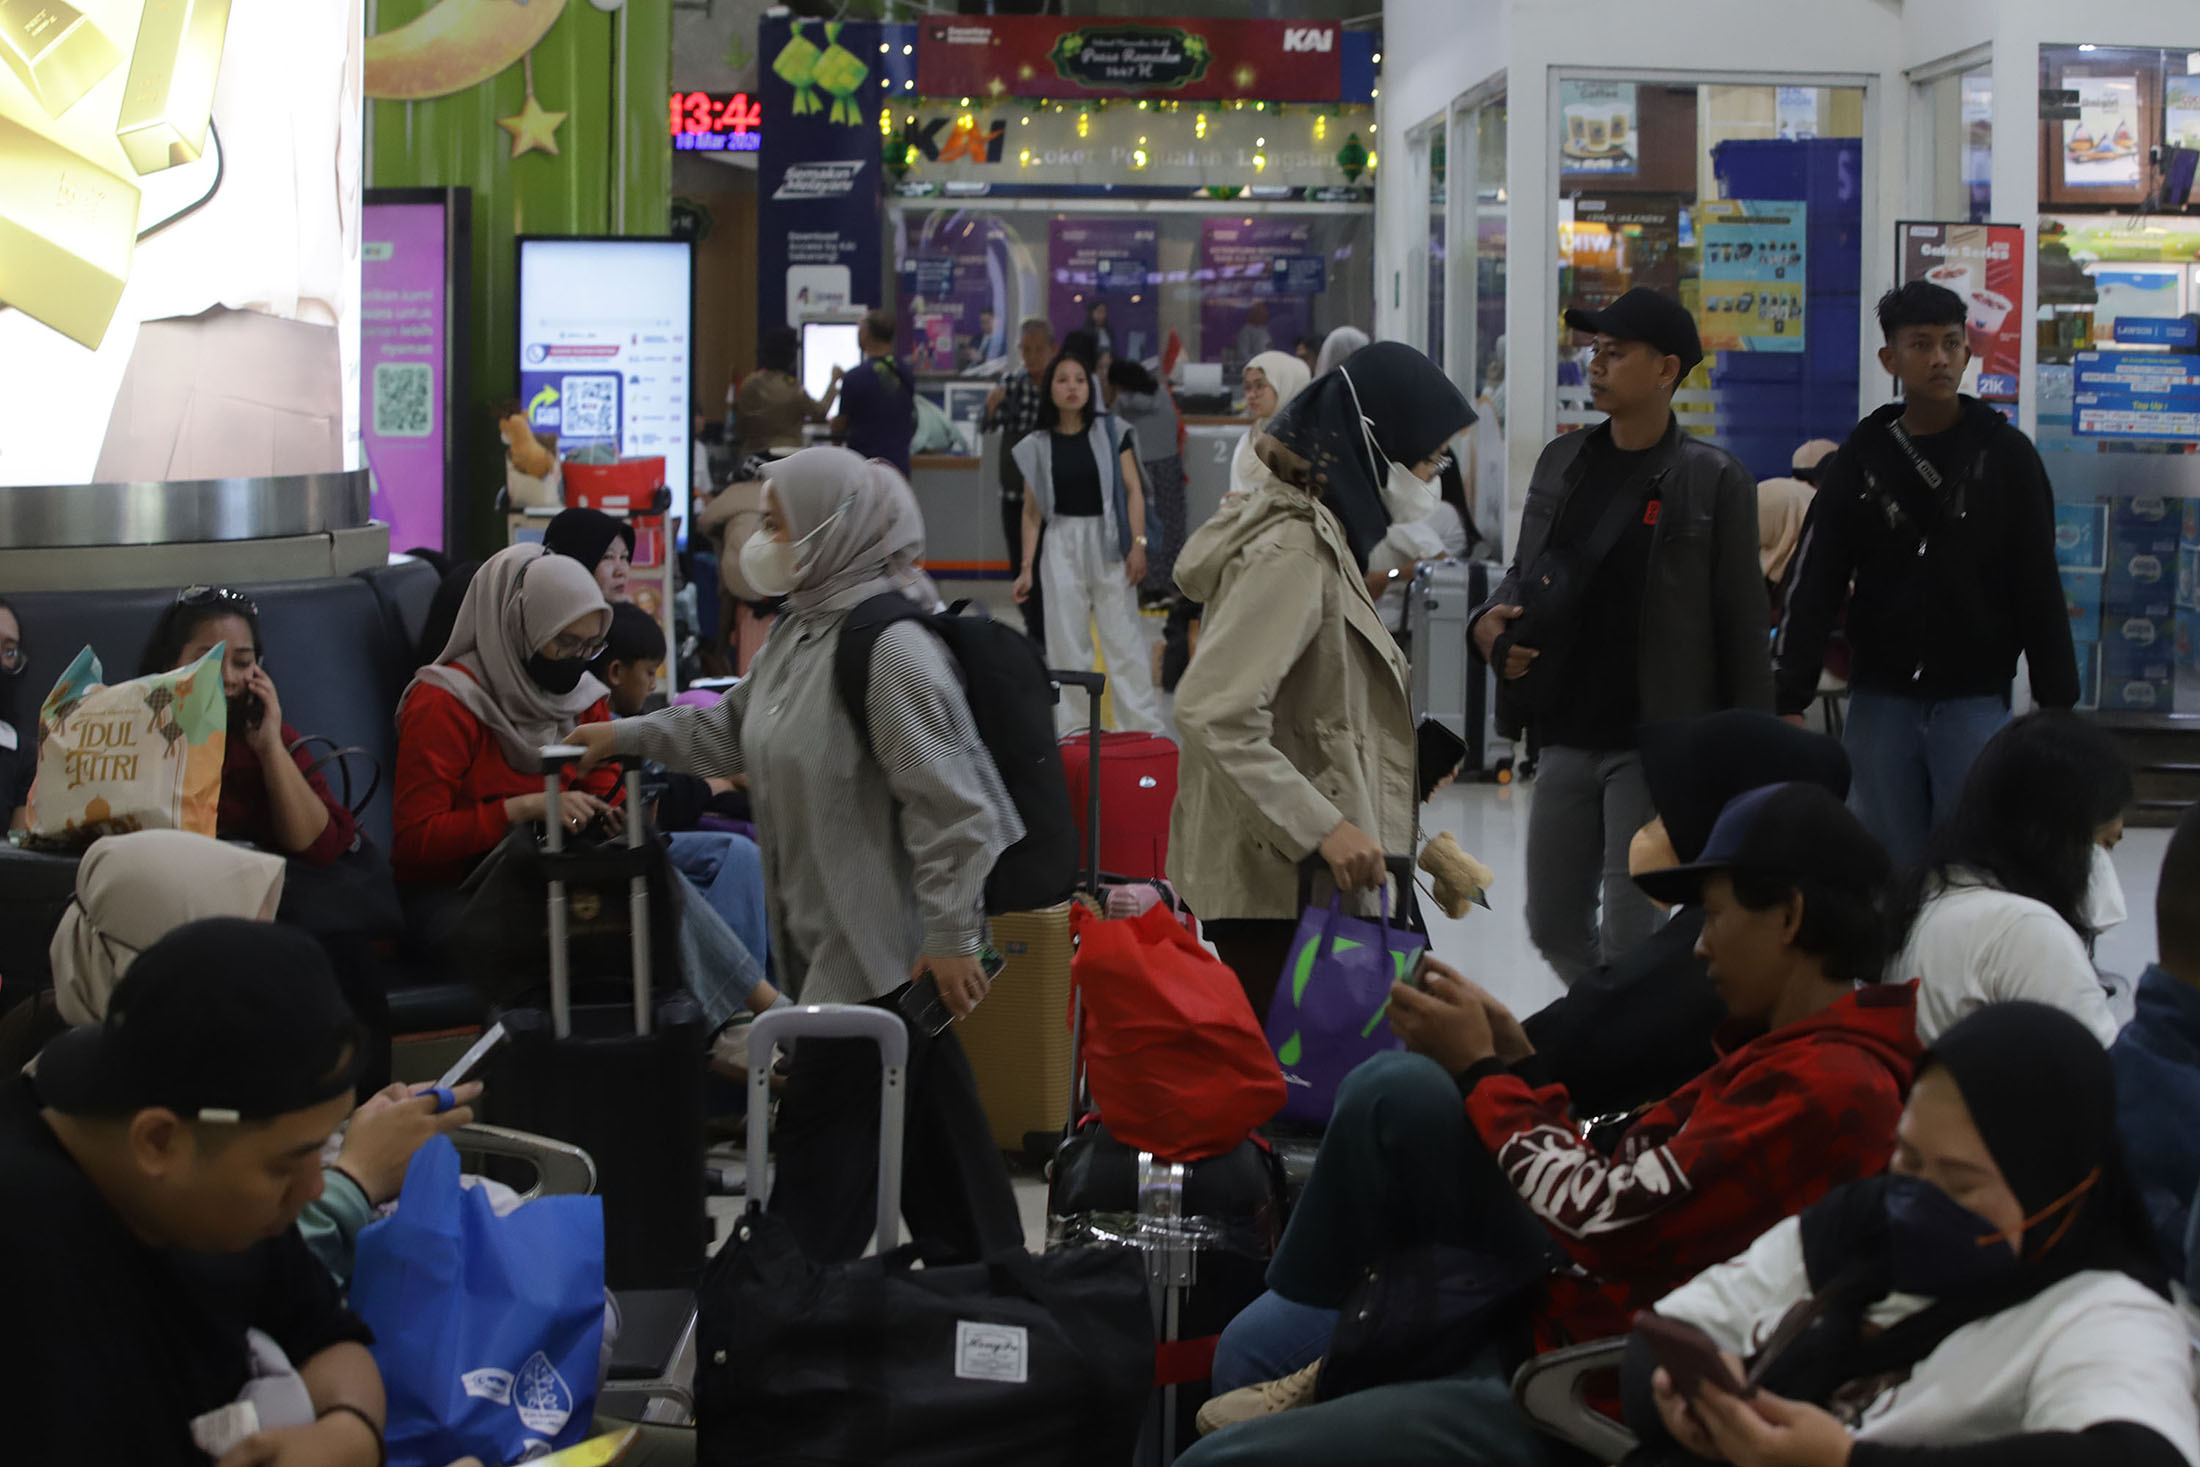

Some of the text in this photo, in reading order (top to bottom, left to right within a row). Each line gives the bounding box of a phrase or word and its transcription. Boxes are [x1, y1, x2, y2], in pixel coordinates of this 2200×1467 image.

[1283, 28, 1334, 53] KAI
[1920, 243, 1959, 257] Cake
[1979, 378, 2004, 393] 21K
[1212, 439, 1228, 464] 2
[70, 720, 137, 748] IDUL
[65, 750, 139, 790] FITRI
